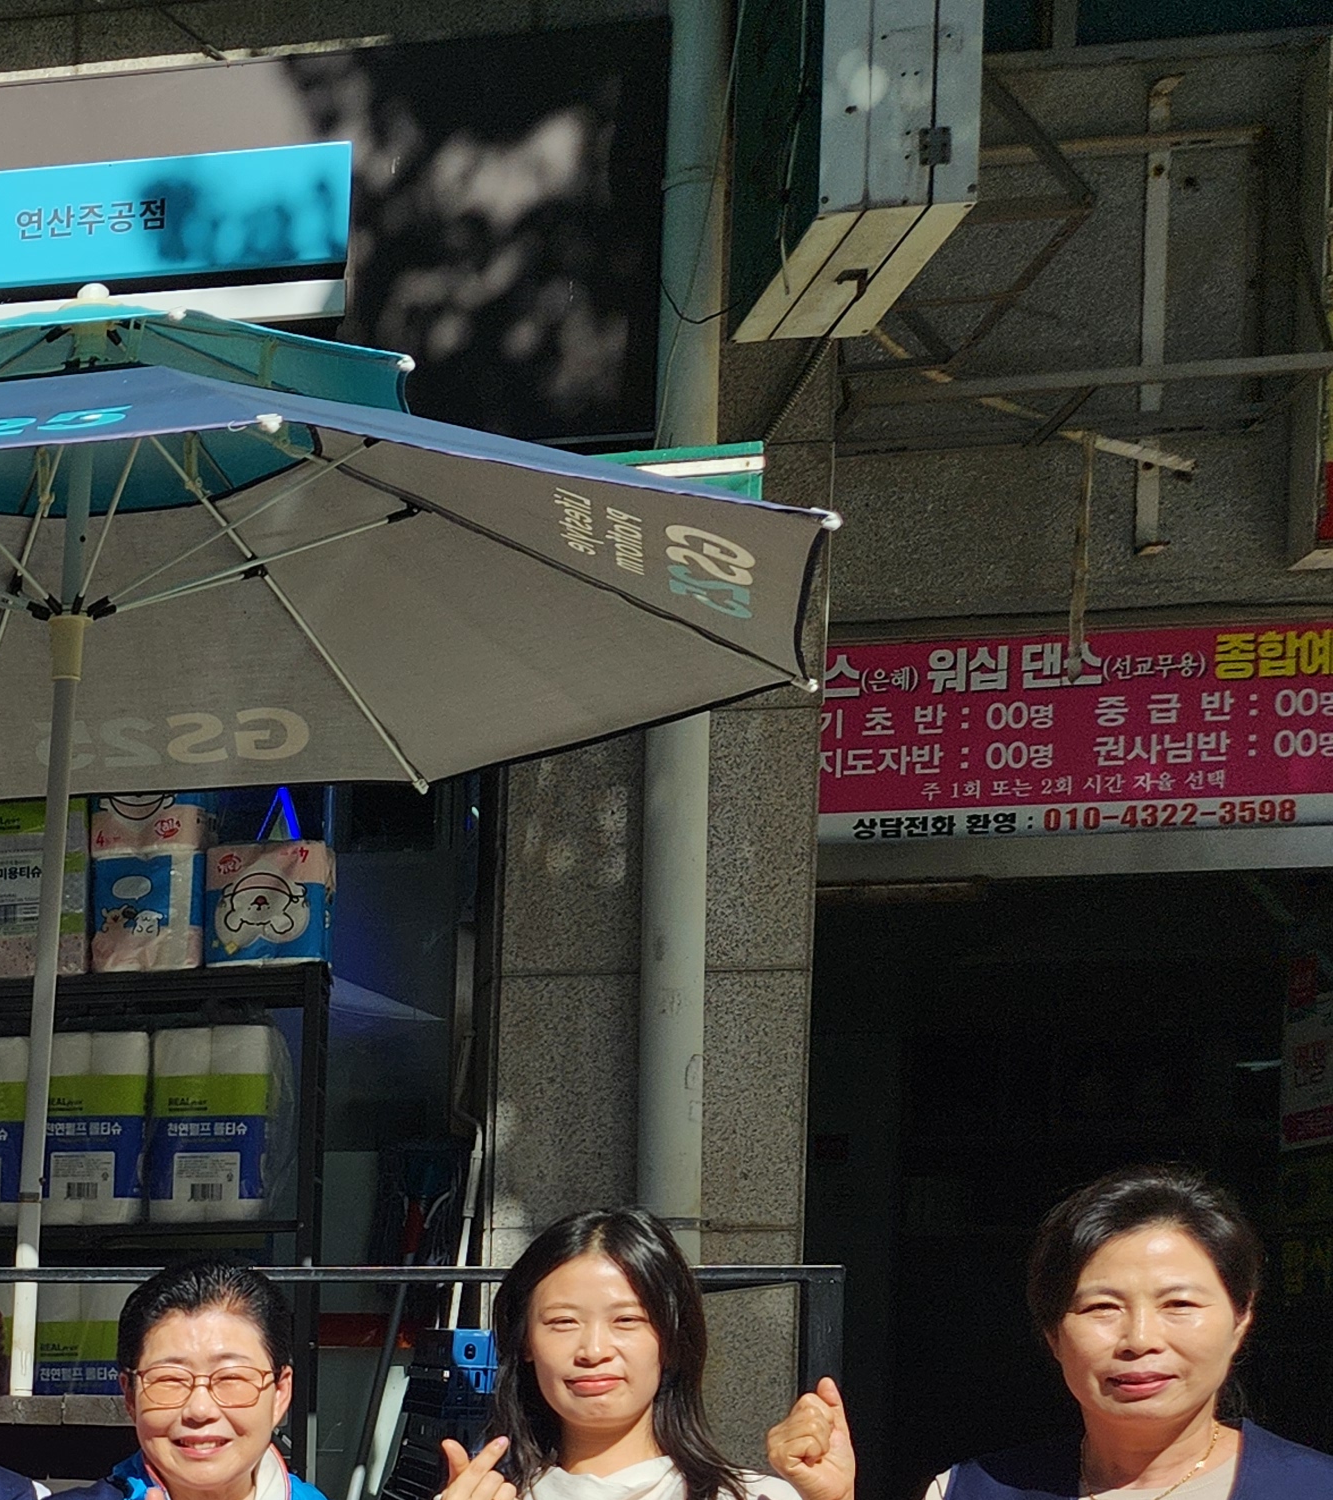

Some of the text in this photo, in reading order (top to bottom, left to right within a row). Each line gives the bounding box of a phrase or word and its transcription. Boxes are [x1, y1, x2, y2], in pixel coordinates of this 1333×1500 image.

[15, 198, 168, 241] 연산주공점
[928, 645, 1008, 693] 워십
[1093, 731, 1231, 768] 권사님반
[991, 776, 1033, 798] 또는
[1041, 774, 1073, 797] 2회
[1083, 772, 1126, 795] 시간
[852, 797, 1297, 840] 상담전화 환영 010-4322-3598
[167, 1122, 212, 1137] 천연펄프
